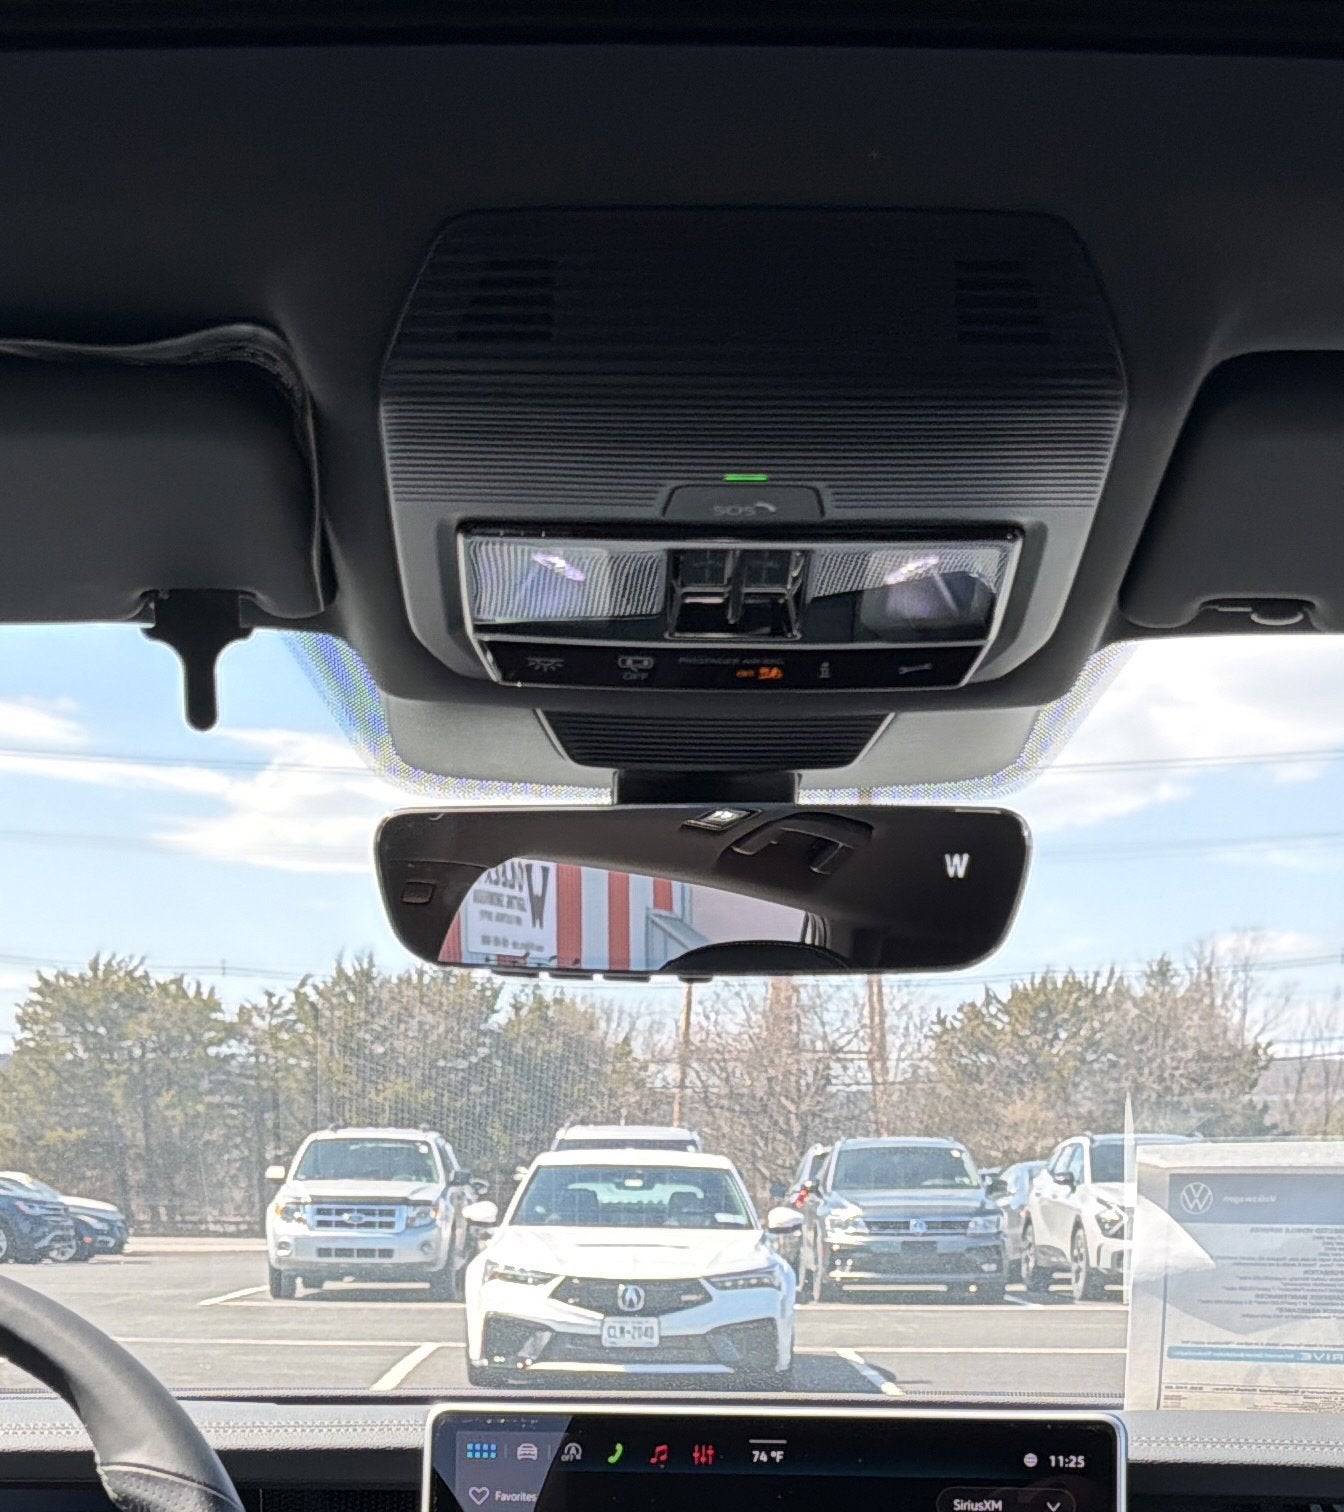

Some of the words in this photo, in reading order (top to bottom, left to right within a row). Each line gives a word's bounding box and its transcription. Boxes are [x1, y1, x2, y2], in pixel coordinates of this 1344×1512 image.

[714, 506, 755, 515] SOS
[945, 853, 968, 878] W
[752, 1450, 768, 1463] 74
[770, 1449, 784, 1463] °F
[1049, 1454, 1085, 1469] 11:25
[495, 1490, 537, 1502] Favorites
[952, 1499, 1003, 1512] SiriusXM
